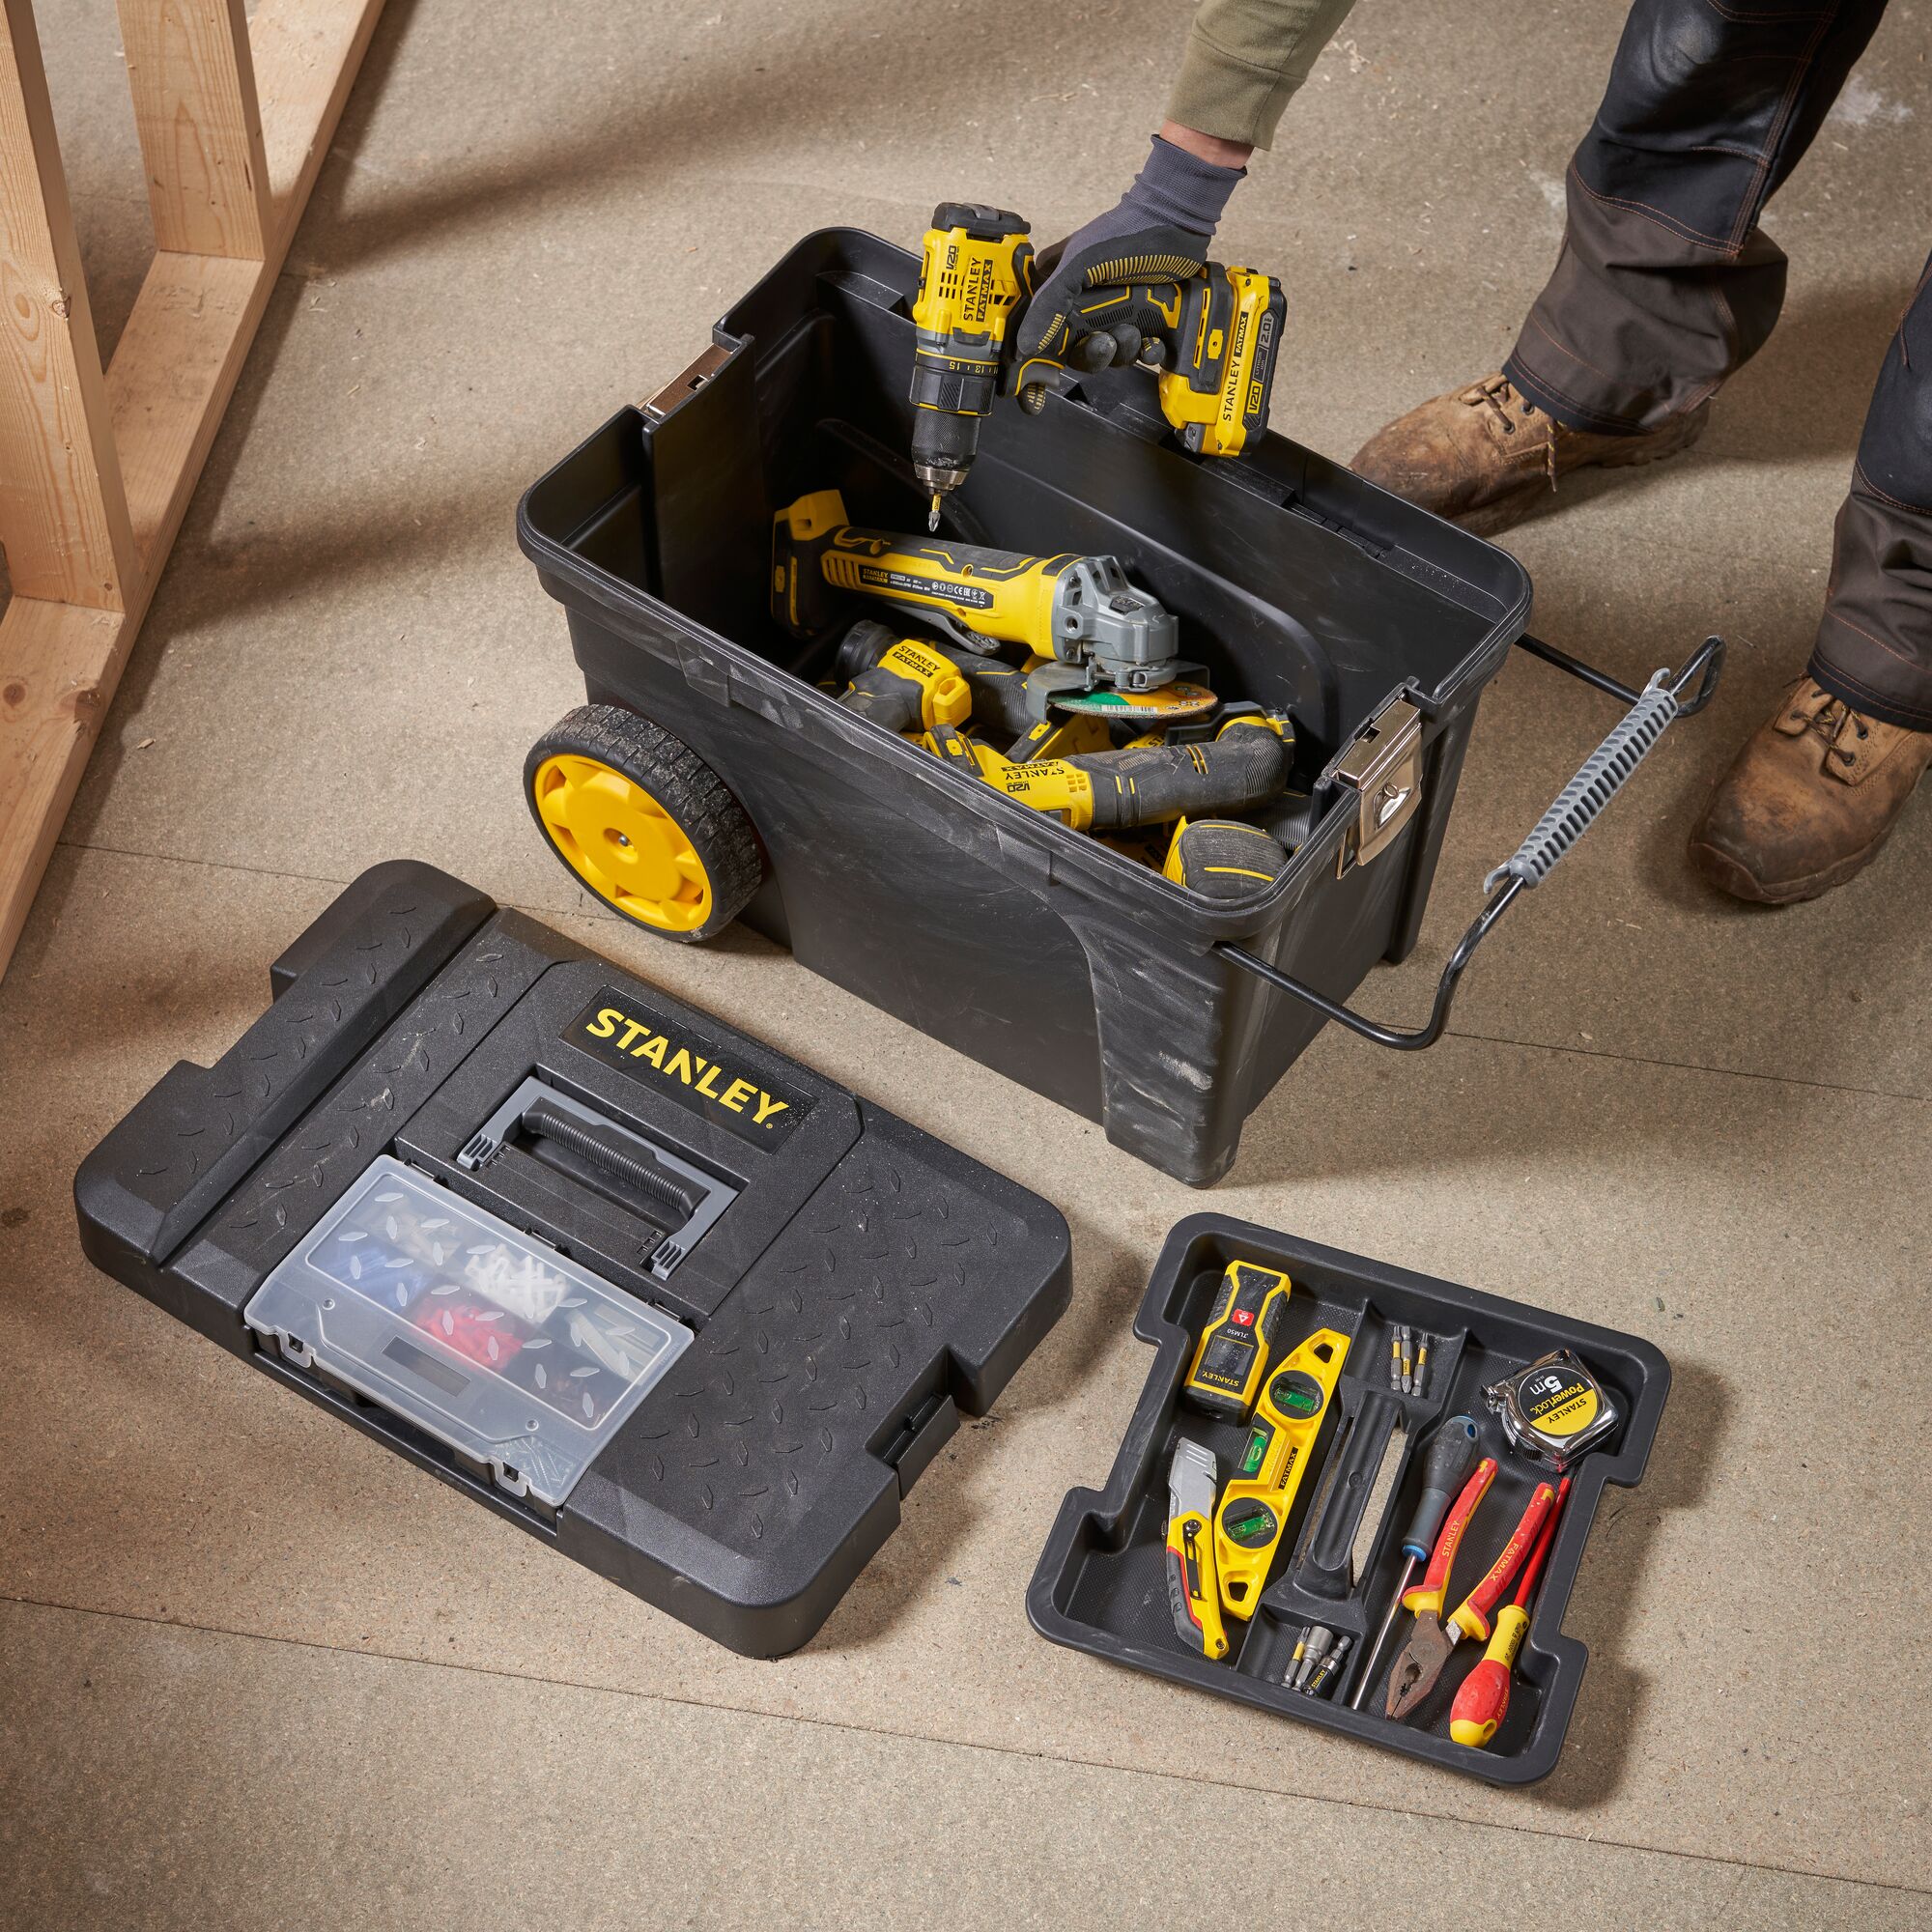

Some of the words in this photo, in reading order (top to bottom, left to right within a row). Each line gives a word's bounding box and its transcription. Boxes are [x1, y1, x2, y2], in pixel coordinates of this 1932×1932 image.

[946, 245, 957, 270] V20
[963, 257, 982, 321] STANLEY
[977, 262, 993, 321] FATMAX
[1260, 322, 1271, 343] 2.0
[949, 360, 960, 371] 15
[1223, 361, 1240, 421] STANLEY
[1235, 315, 1248, 355] FATMAX
[1248, 385, 1261, 411] V20
[863, 568, 889, 579] STANLEY
[895, 652, 930, 676] FATMAX
[898, 645, 941, 671] STANLEY
[585, 1008, 789, 1124] STANLEY
[1202, 1370, 1240, 1387] STANLEY
[1529, 1375, 1563, 1395] 5m
[1548, 1398, 1587, 1424] STANLEY
[1280, 1452, 1296, 1486] FATMAX
[1441, 1520, 1461, 1557] STANLEY
[1490, 1543, 1520, 1581] FATMAX
[1311, 1669, 1326, 1689] STANLEY
